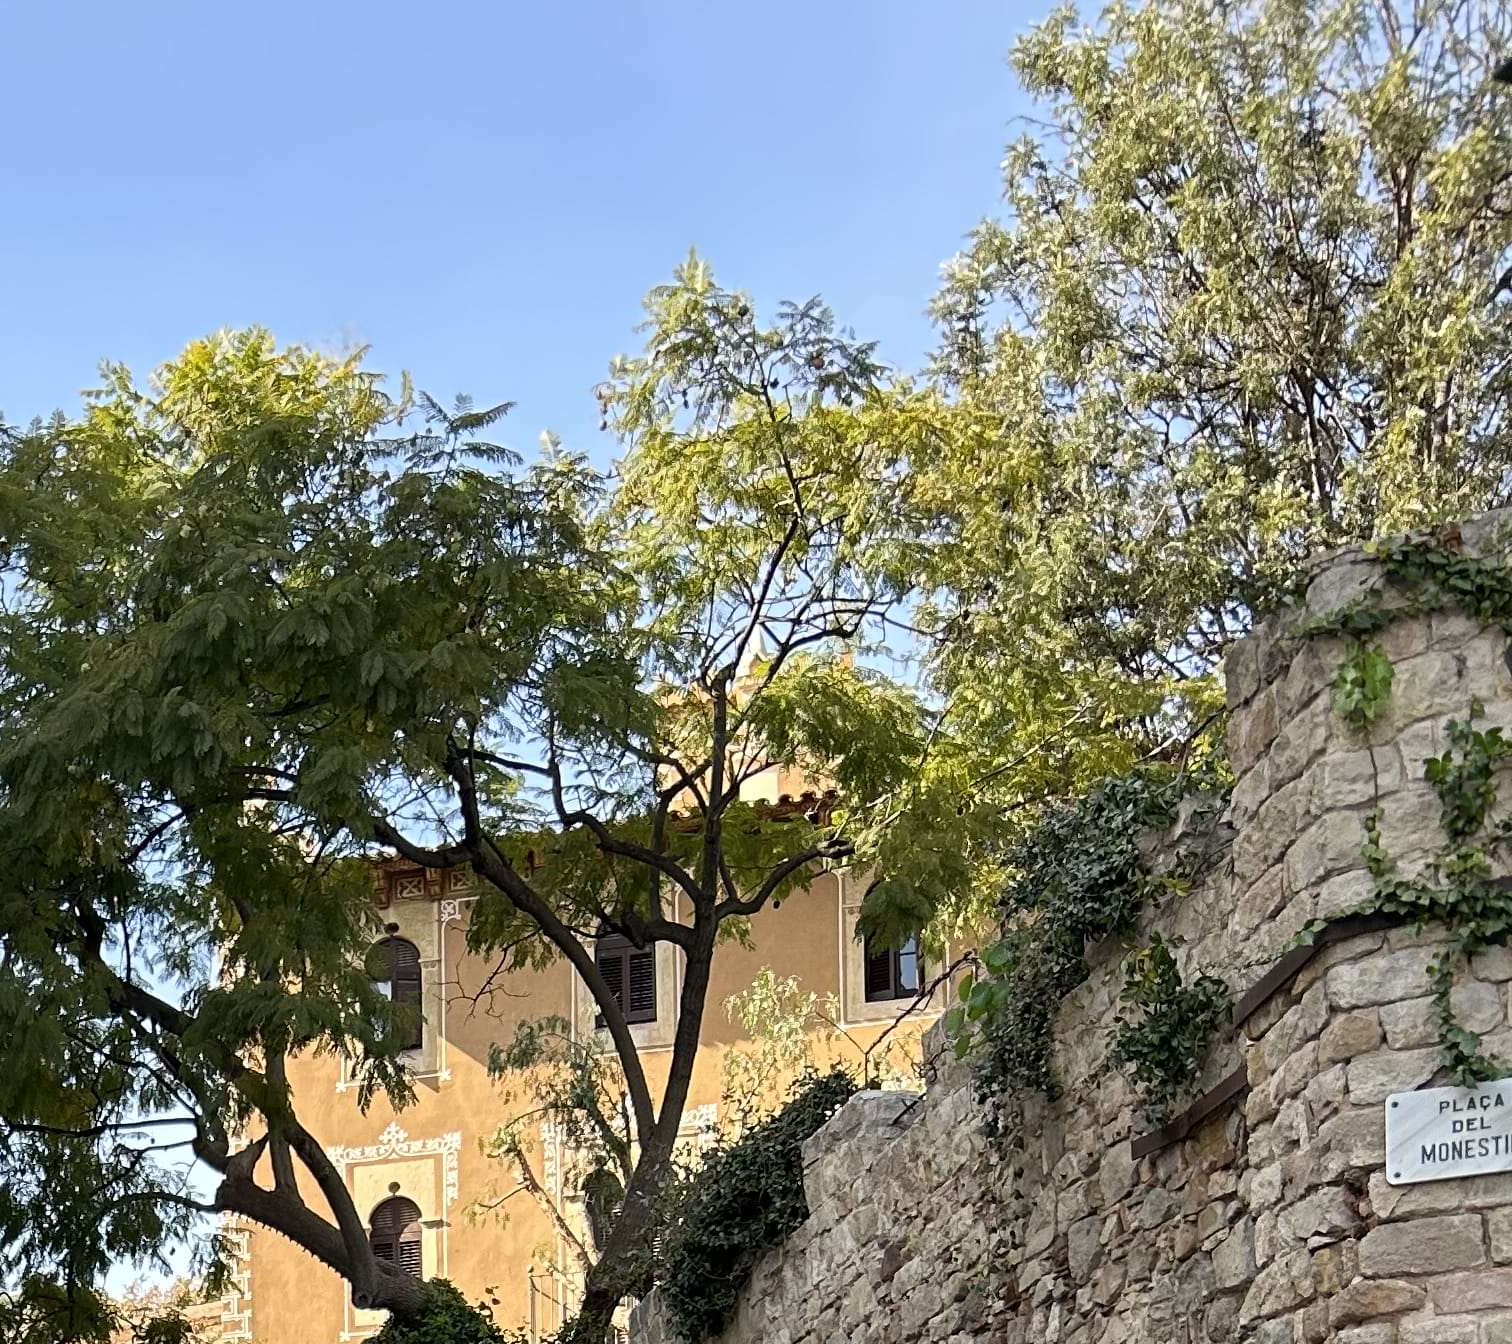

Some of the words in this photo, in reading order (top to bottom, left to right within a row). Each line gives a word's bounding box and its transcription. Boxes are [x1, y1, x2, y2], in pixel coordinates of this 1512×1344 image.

[1439, 1093, 1504, 1114] PLAÇA
[1452, 1117, 1492, 1133] DEL
[1421, 1134, 1512, 1164] MONESTI
